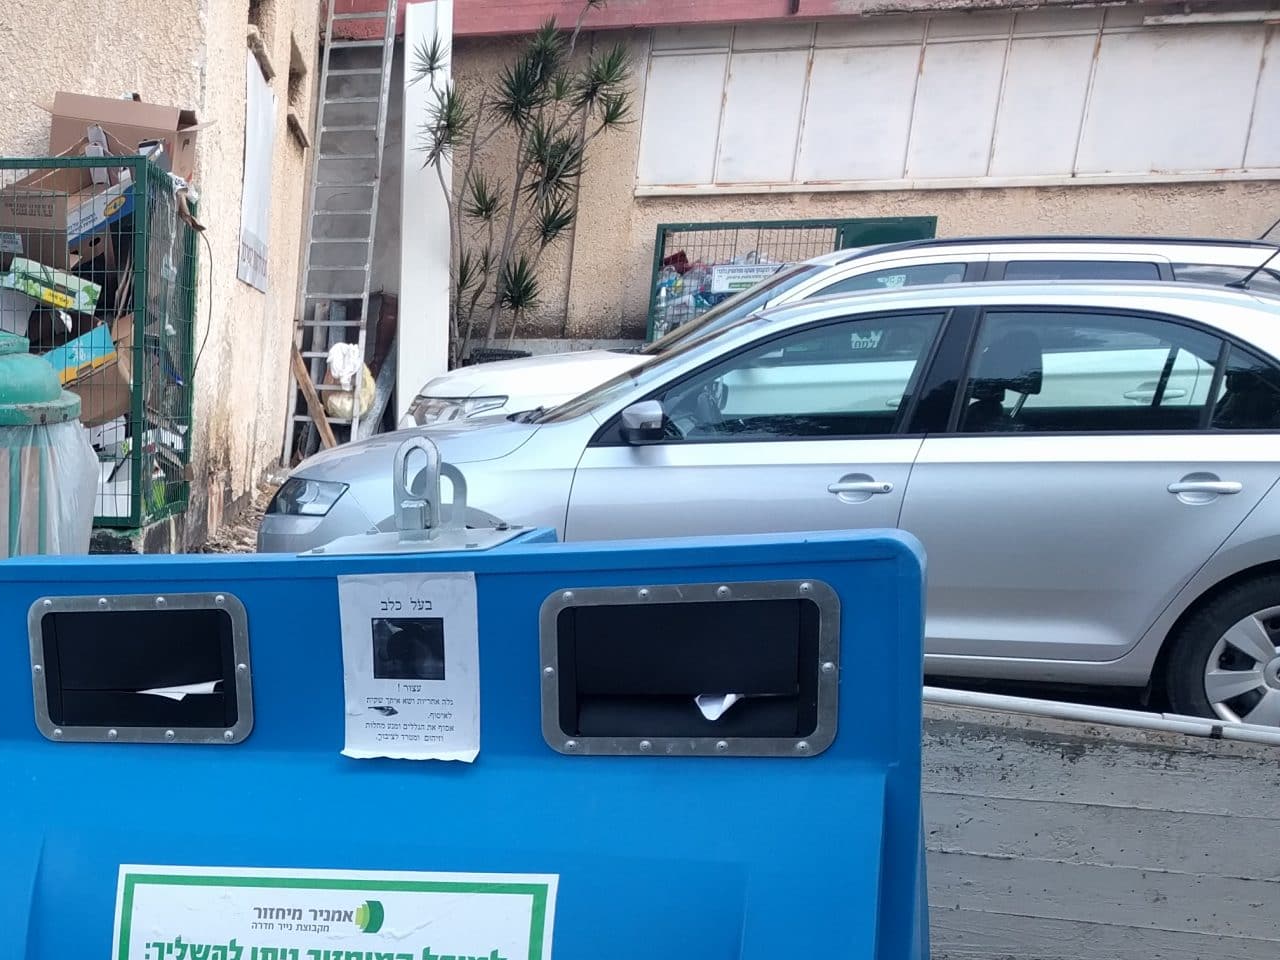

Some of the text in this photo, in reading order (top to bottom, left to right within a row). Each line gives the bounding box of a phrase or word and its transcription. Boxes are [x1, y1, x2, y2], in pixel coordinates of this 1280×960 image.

[381, 597, 432, 611] בעל כלב
[253, 906, 354, 923] אמניר מיחזור
[251, 920, 274, 930] חדרה
[277, 921, 293, 931] נייר
